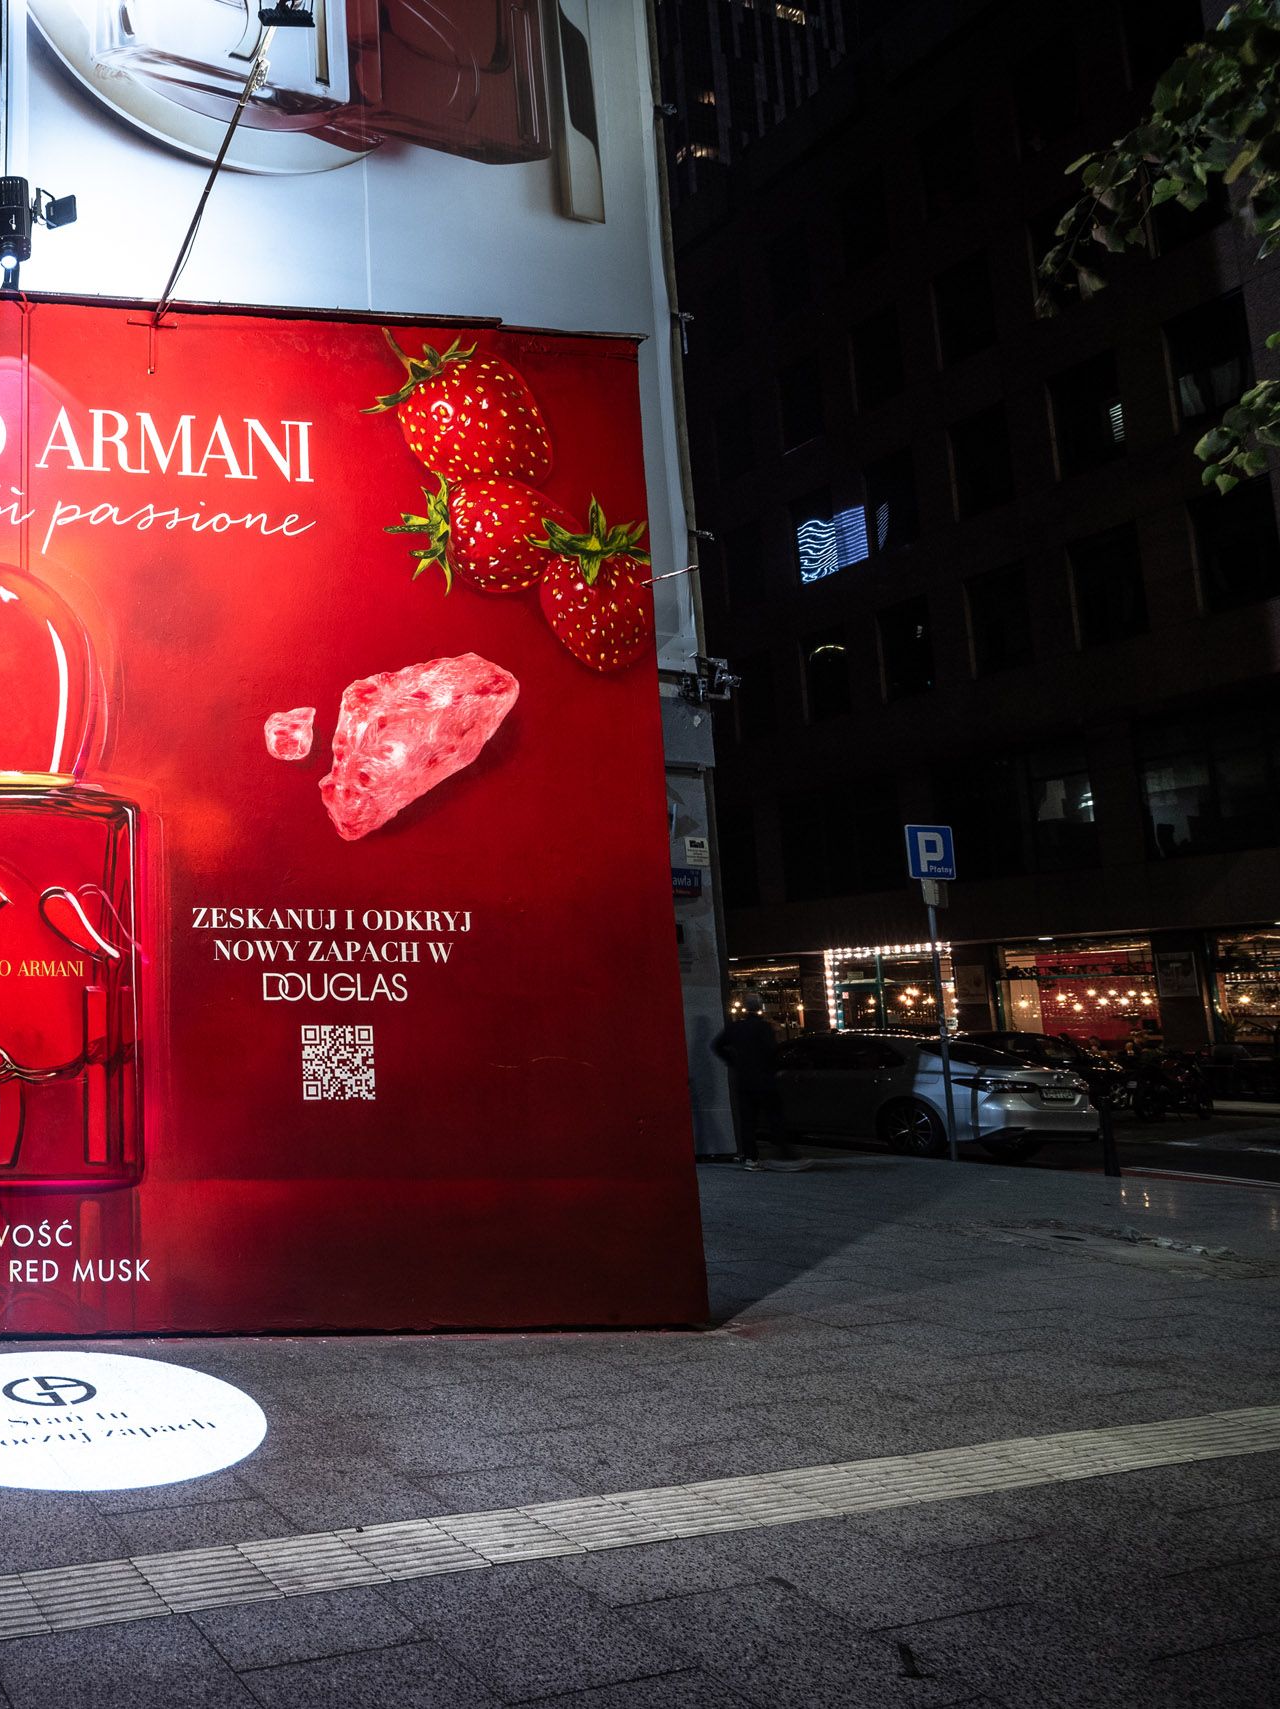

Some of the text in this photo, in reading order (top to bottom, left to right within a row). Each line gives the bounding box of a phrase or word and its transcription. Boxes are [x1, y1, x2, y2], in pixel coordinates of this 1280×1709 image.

[35, 406, 314, 482] ARMANI
[42, 499, 315, 554] passione
[917, 832, 945, 872] P
[192, 907, 472, 932] ZESKANUJ I ODKRYJ
[213, 939, 454, 963] NOWY ZAPACH W
[17, 960, 84, 977] ARMANI
[262, 972, 408, 1001] DOUGLAS
[9, 1260, 59, 1283] RED
[72, 1259, 150, 1282] MUSK
[106, 1418, 217, 1438] zapach
